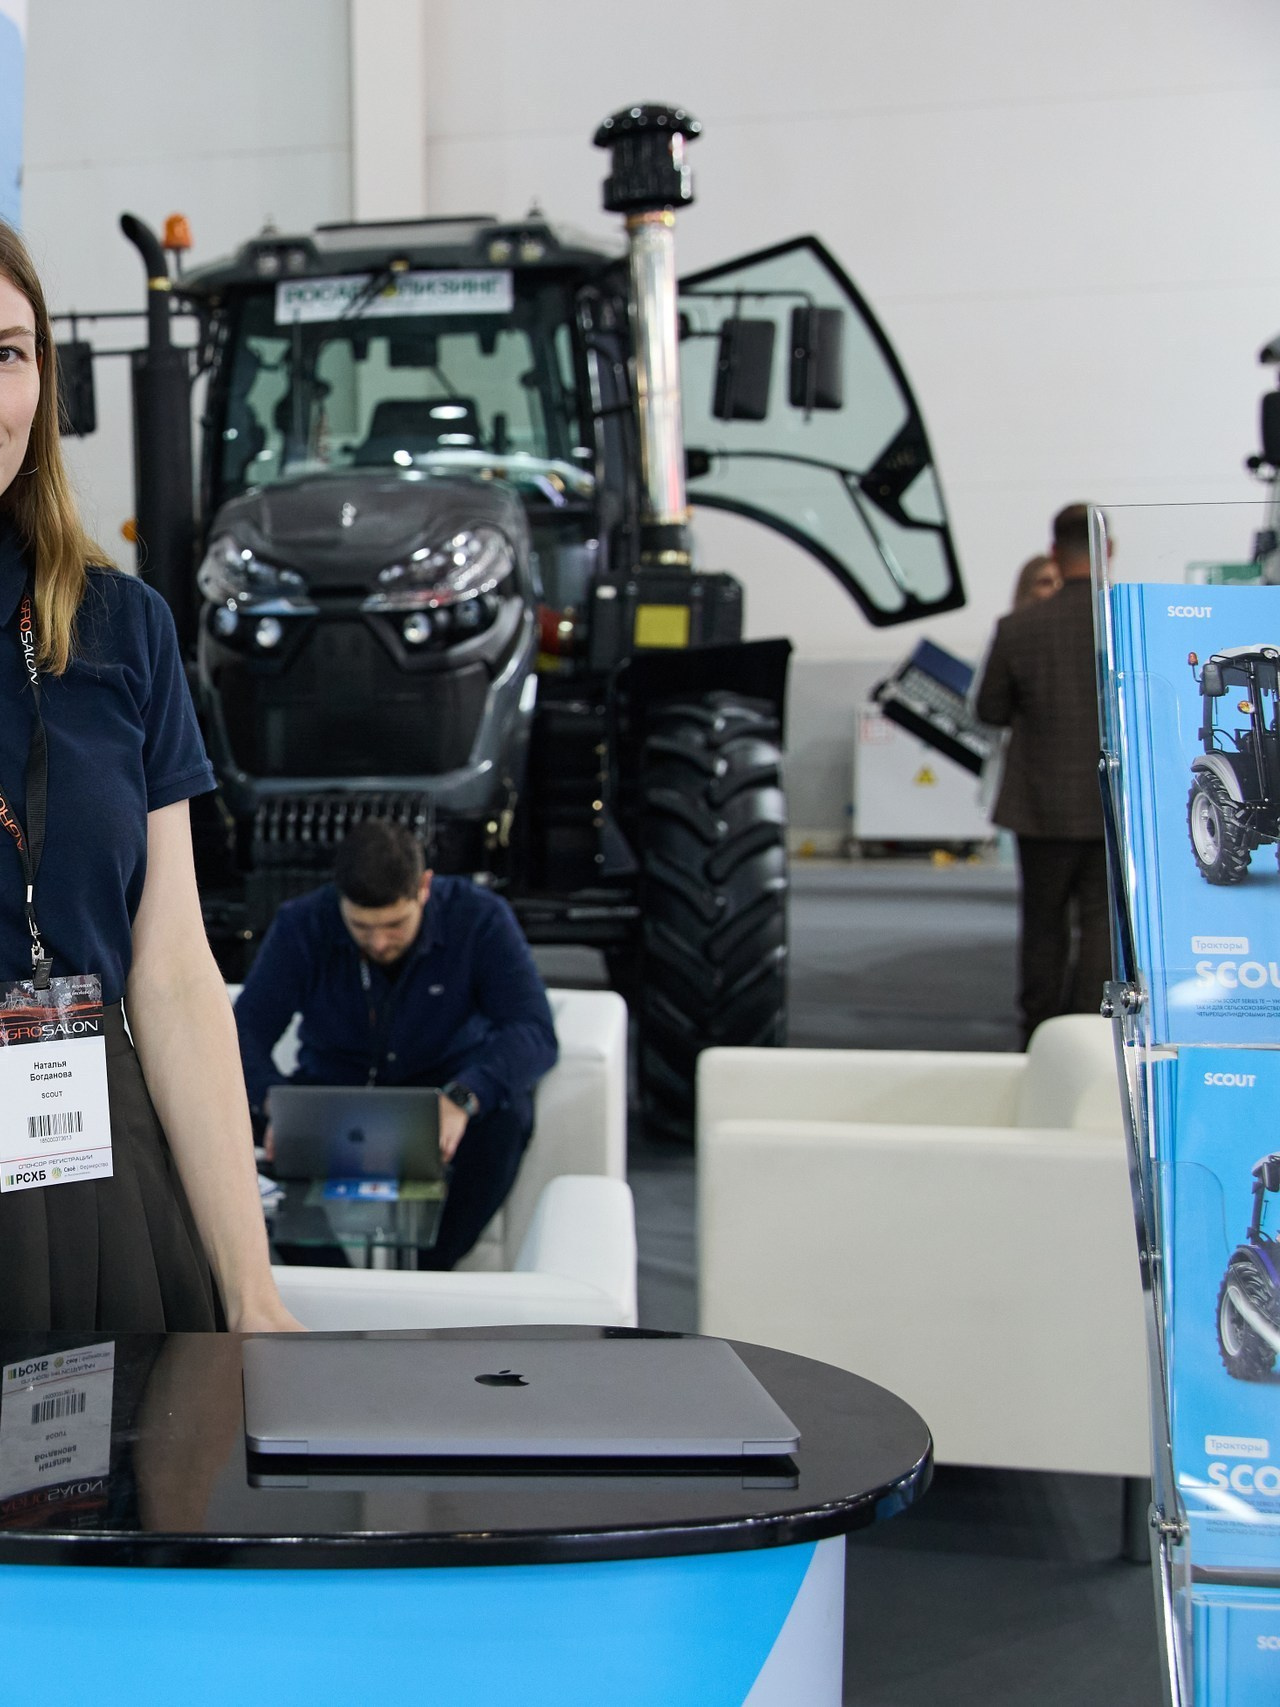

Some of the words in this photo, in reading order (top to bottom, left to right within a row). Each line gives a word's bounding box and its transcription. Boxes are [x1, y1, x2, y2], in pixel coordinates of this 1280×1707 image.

[1167, 605, 1212, 618] SCOUT
[1196, 941, 1243, 951] Тракторы
[33, 1061, 67, 1070] Наталья
[30, 1071, 72, 1081] Богданова
[1204, 1072, 1256, 1087] SCOUT
[41, 1091, 63, 1099] SCOUT
[16, 1170, 47, 1184] РСХБ
[1211, 1440, 1263, 1453] Тракторы
